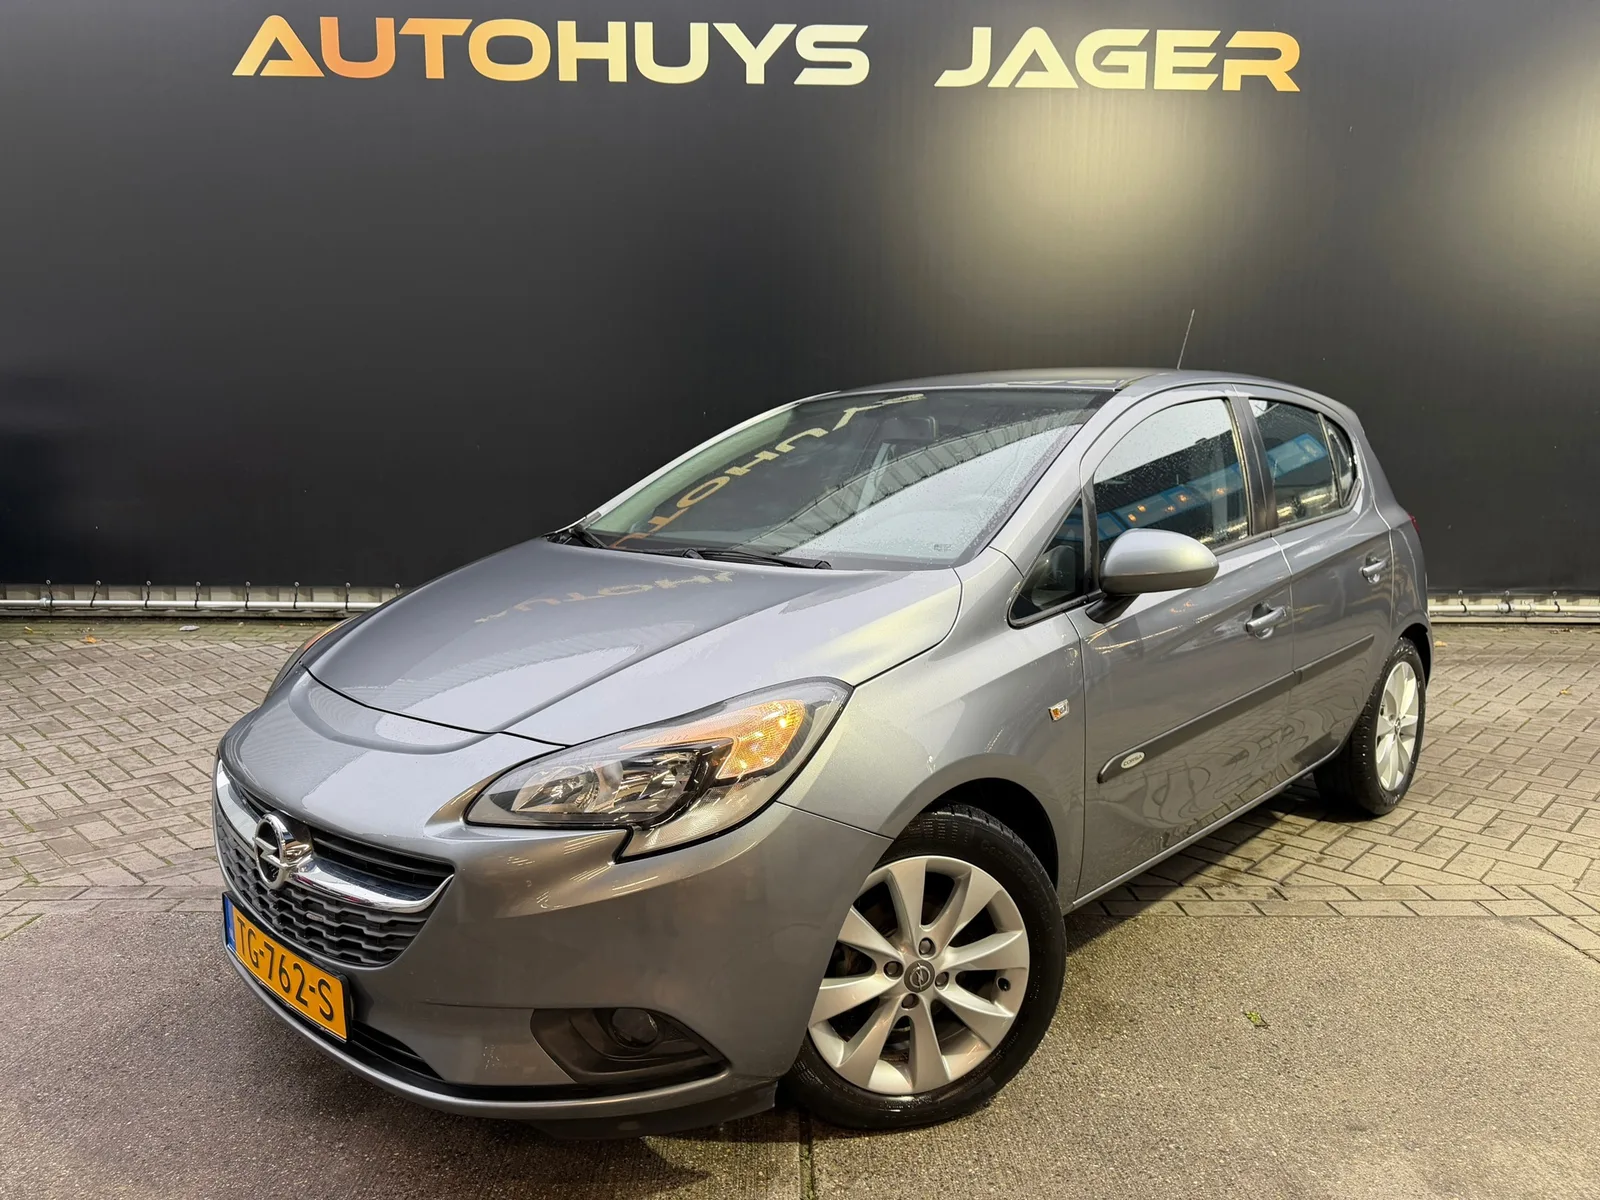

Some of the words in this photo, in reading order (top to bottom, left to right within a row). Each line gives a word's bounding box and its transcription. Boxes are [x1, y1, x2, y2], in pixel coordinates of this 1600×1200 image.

[232, 15, 870, 85] AUTOHUYS
[934, 26, 1300, 92] JAGER
[237, 917, 334, 1022] TG-762-S
